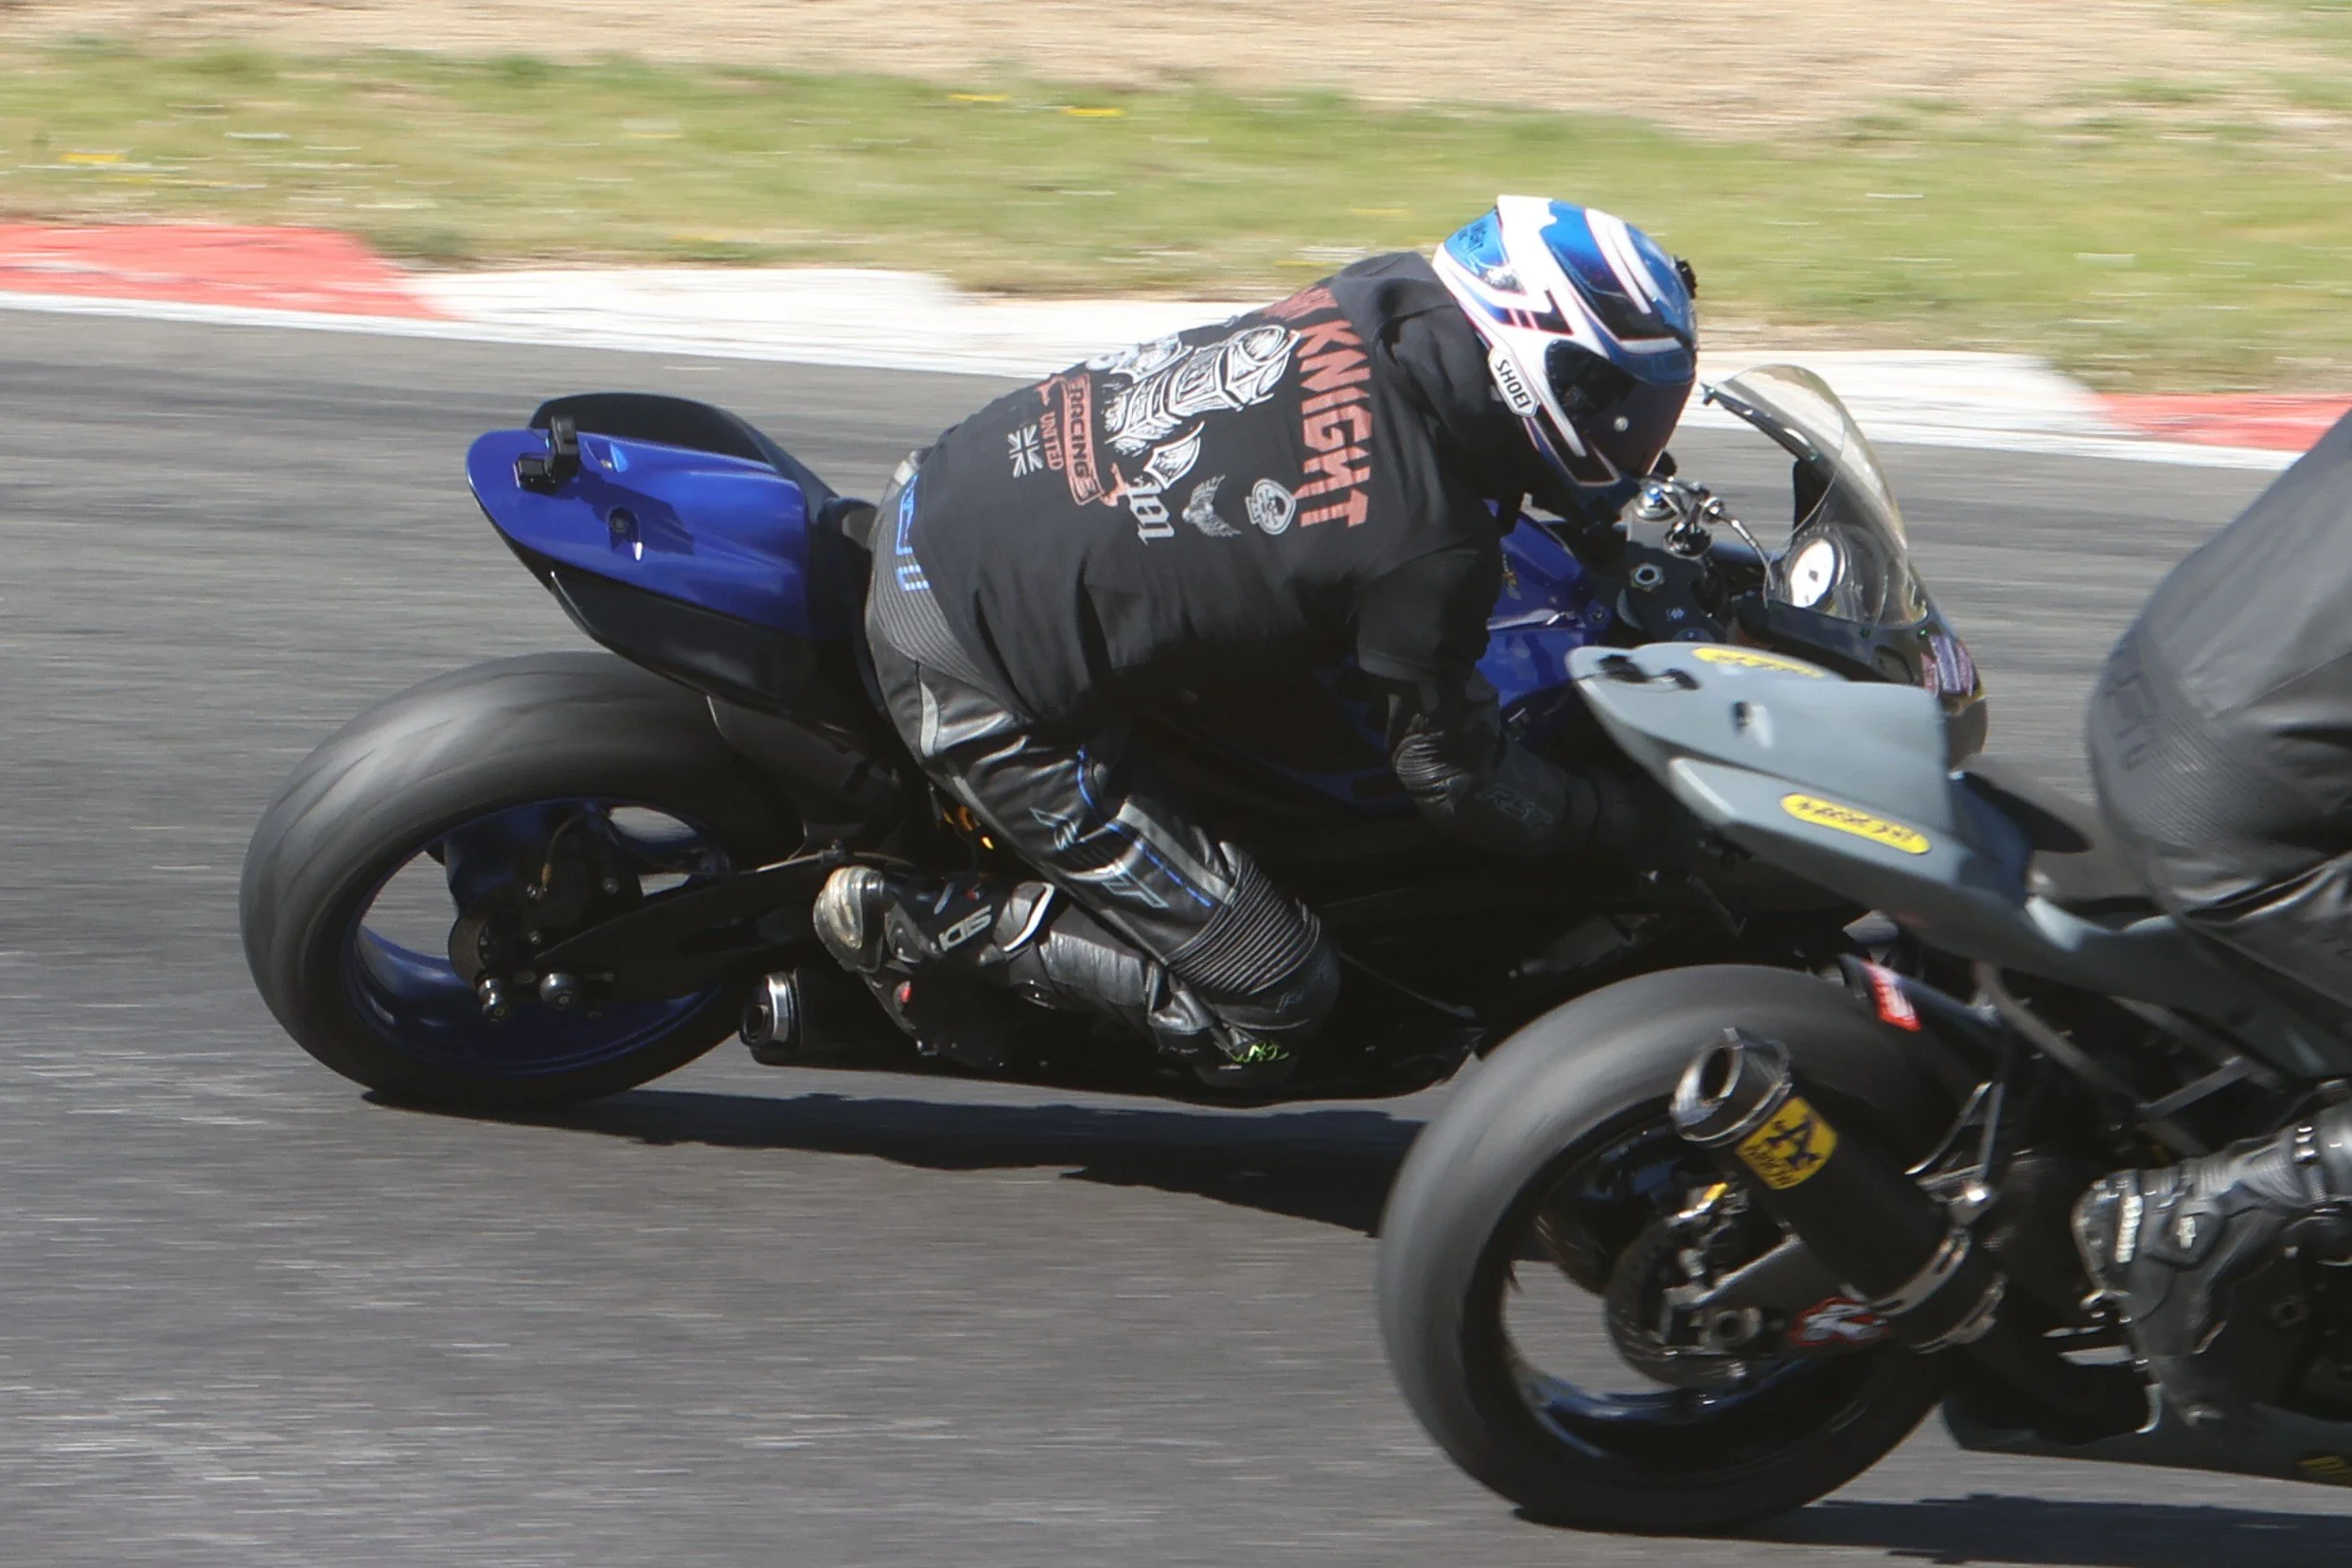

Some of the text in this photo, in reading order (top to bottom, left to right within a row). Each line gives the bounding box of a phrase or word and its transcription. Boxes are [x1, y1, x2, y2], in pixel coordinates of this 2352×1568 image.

[1494, 359, 1531, 409] SHOEI
[1040, 412, 1065, 470] UNITED
[1068, 385, 1090, 478] RACING
[1293, 319, 1372, 528] KNIGHT
